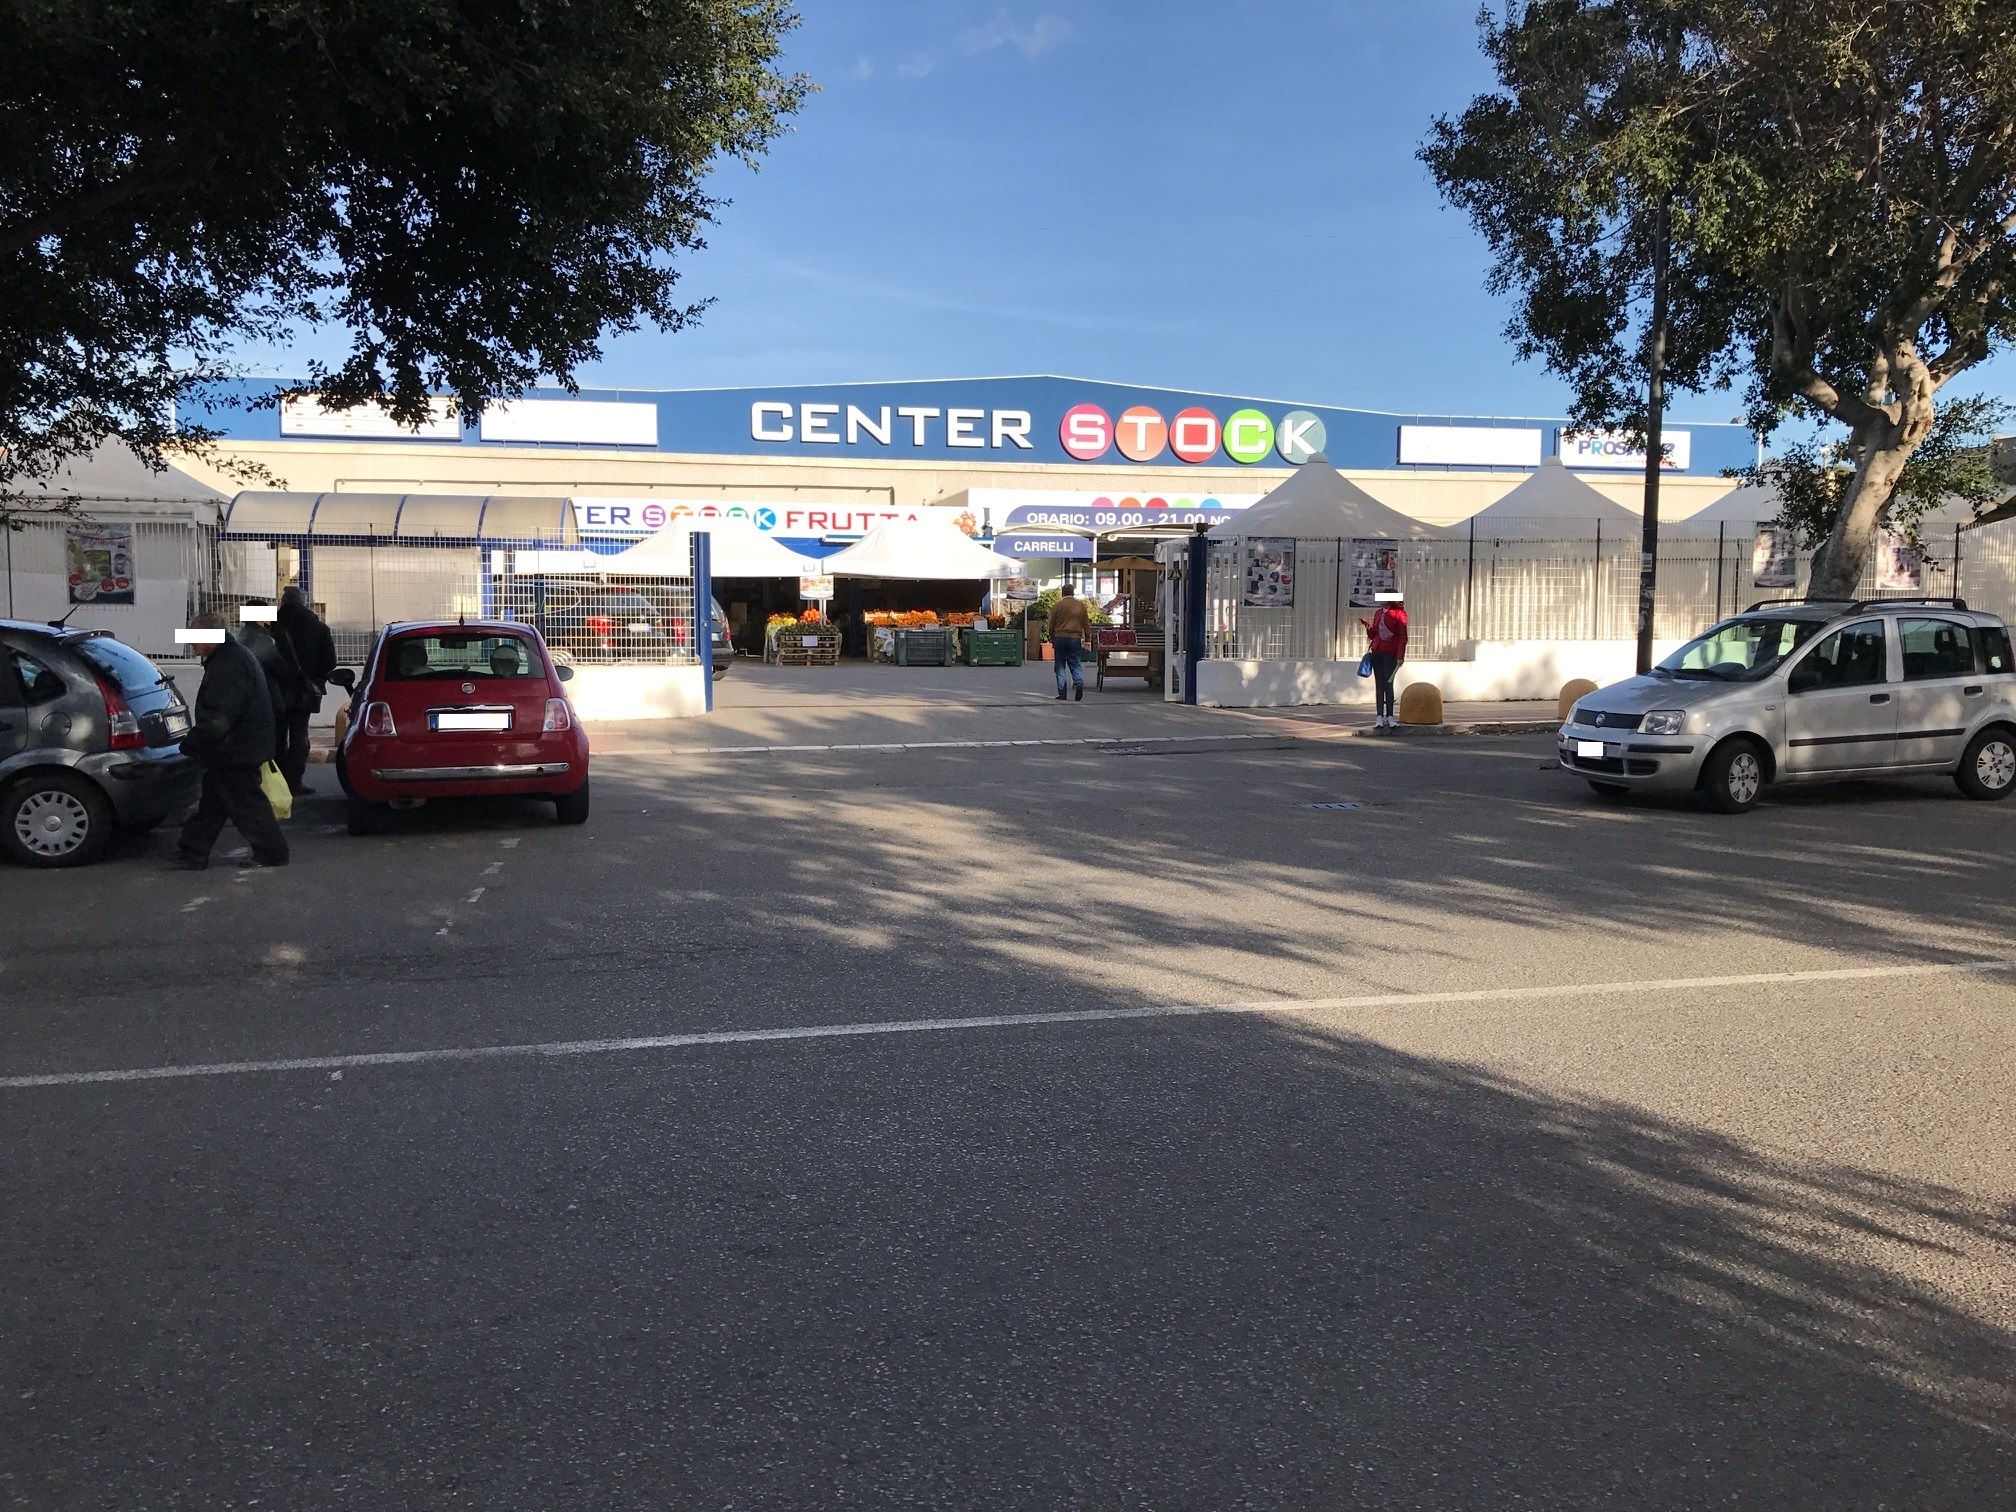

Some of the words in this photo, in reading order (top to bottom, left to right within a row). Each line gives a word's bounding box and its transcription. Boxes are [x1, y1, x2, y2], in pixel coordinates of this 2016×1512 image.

[750, 401, 1033, 450] CENTER
[1065, 411, 1318, 458] STOCK
[1578, 440, 1676, 456] PROSP
[573, 505, 632, 526] ER
[1026, 512, 1090, 526] ORARIO:
[1095, 512, 1143, 526] 09.00
[1158, 513, 1206, 525] 2100
[1013, 540, 1074, 553] CARRELLI
